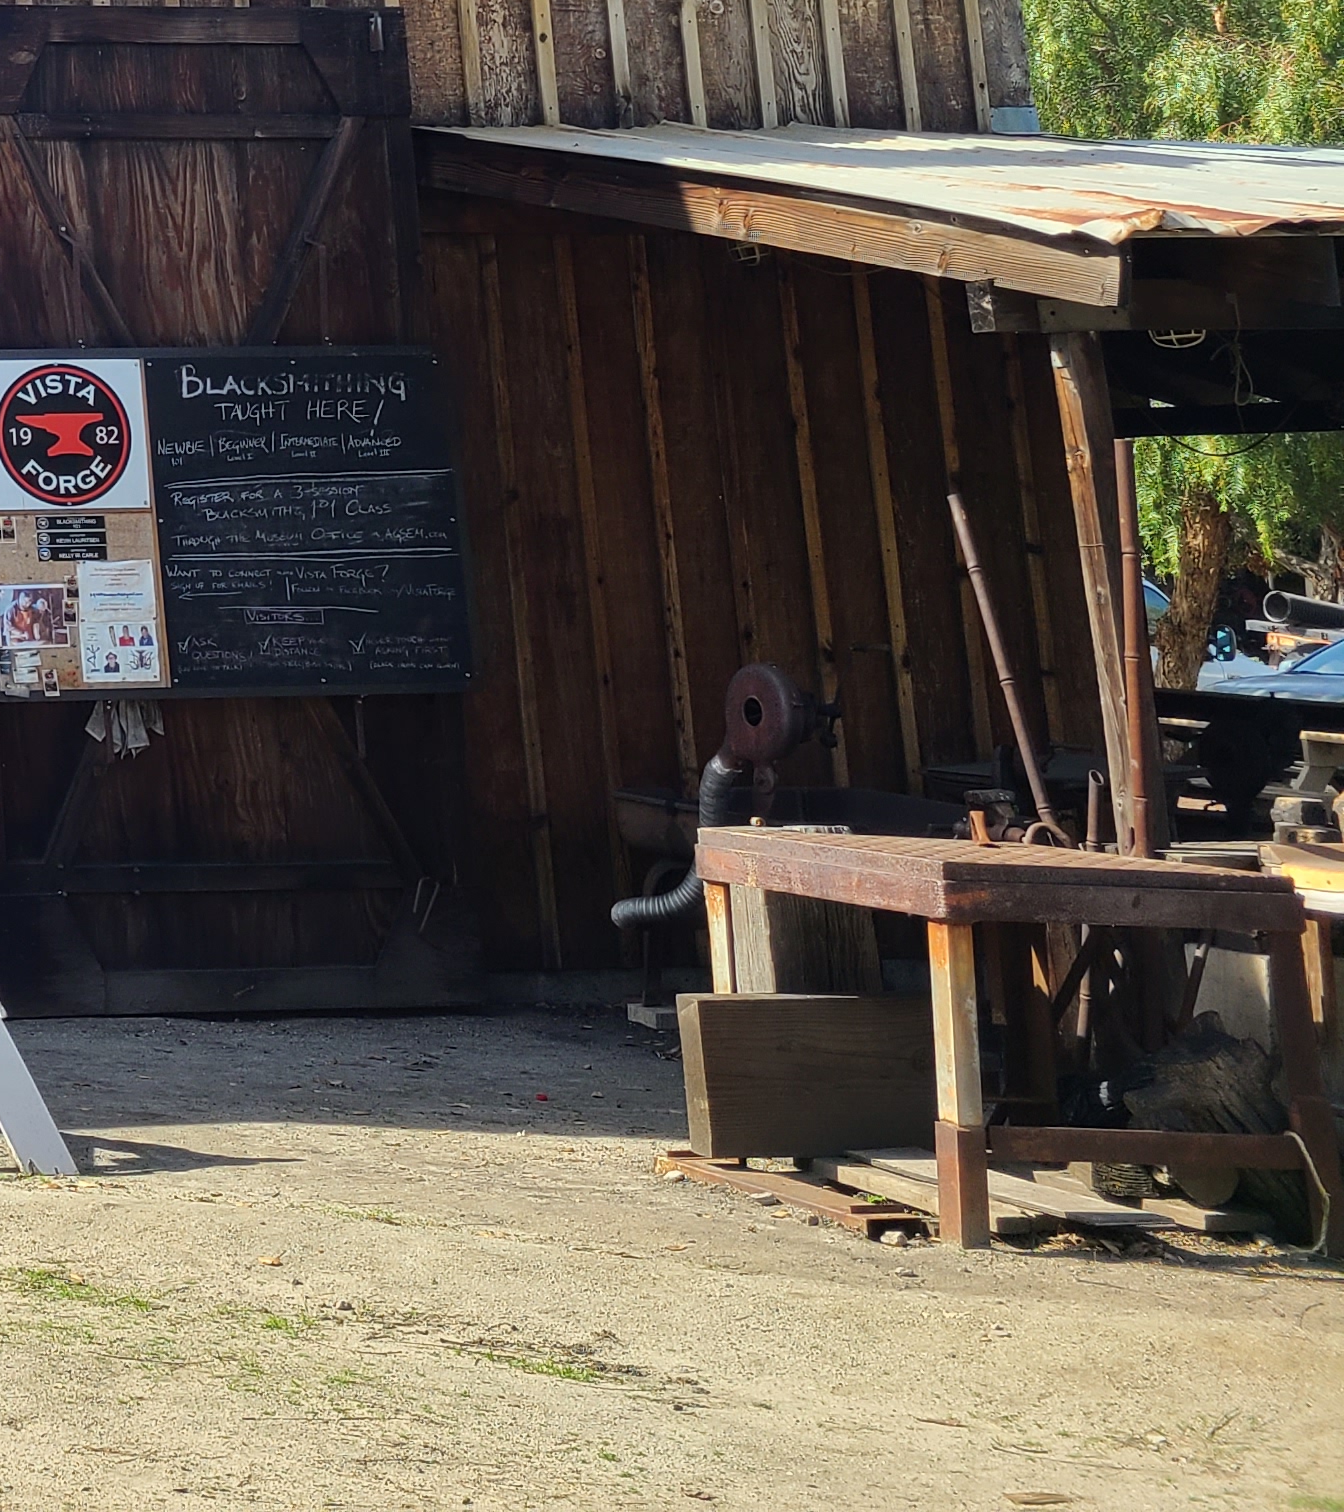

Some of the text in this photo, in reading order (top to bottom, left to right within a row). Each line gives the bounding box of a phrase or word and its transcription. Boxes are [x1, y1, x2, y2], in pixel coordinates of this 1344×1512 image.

[16, 374, 96, 407] VISTA
[213, 399, 291, 426] TAUGHT
[9, 427, 32, 446] 19
[95, 426, 120, 445] 82
[279, 433, 339, 450] INTERMEDIATE
[21, 455, 112, 494] FORGE
[170, 491, 235, 509] REGISTER
[240, 489, 264, 500] FOR
[273, 489, 283, 499] A
[165, 565, 201, 578] WANT
[210, 569, 222, 578] TO
[228, 569, 272, 578] CONNECT
[272, 635, 304, 649] KEEP
